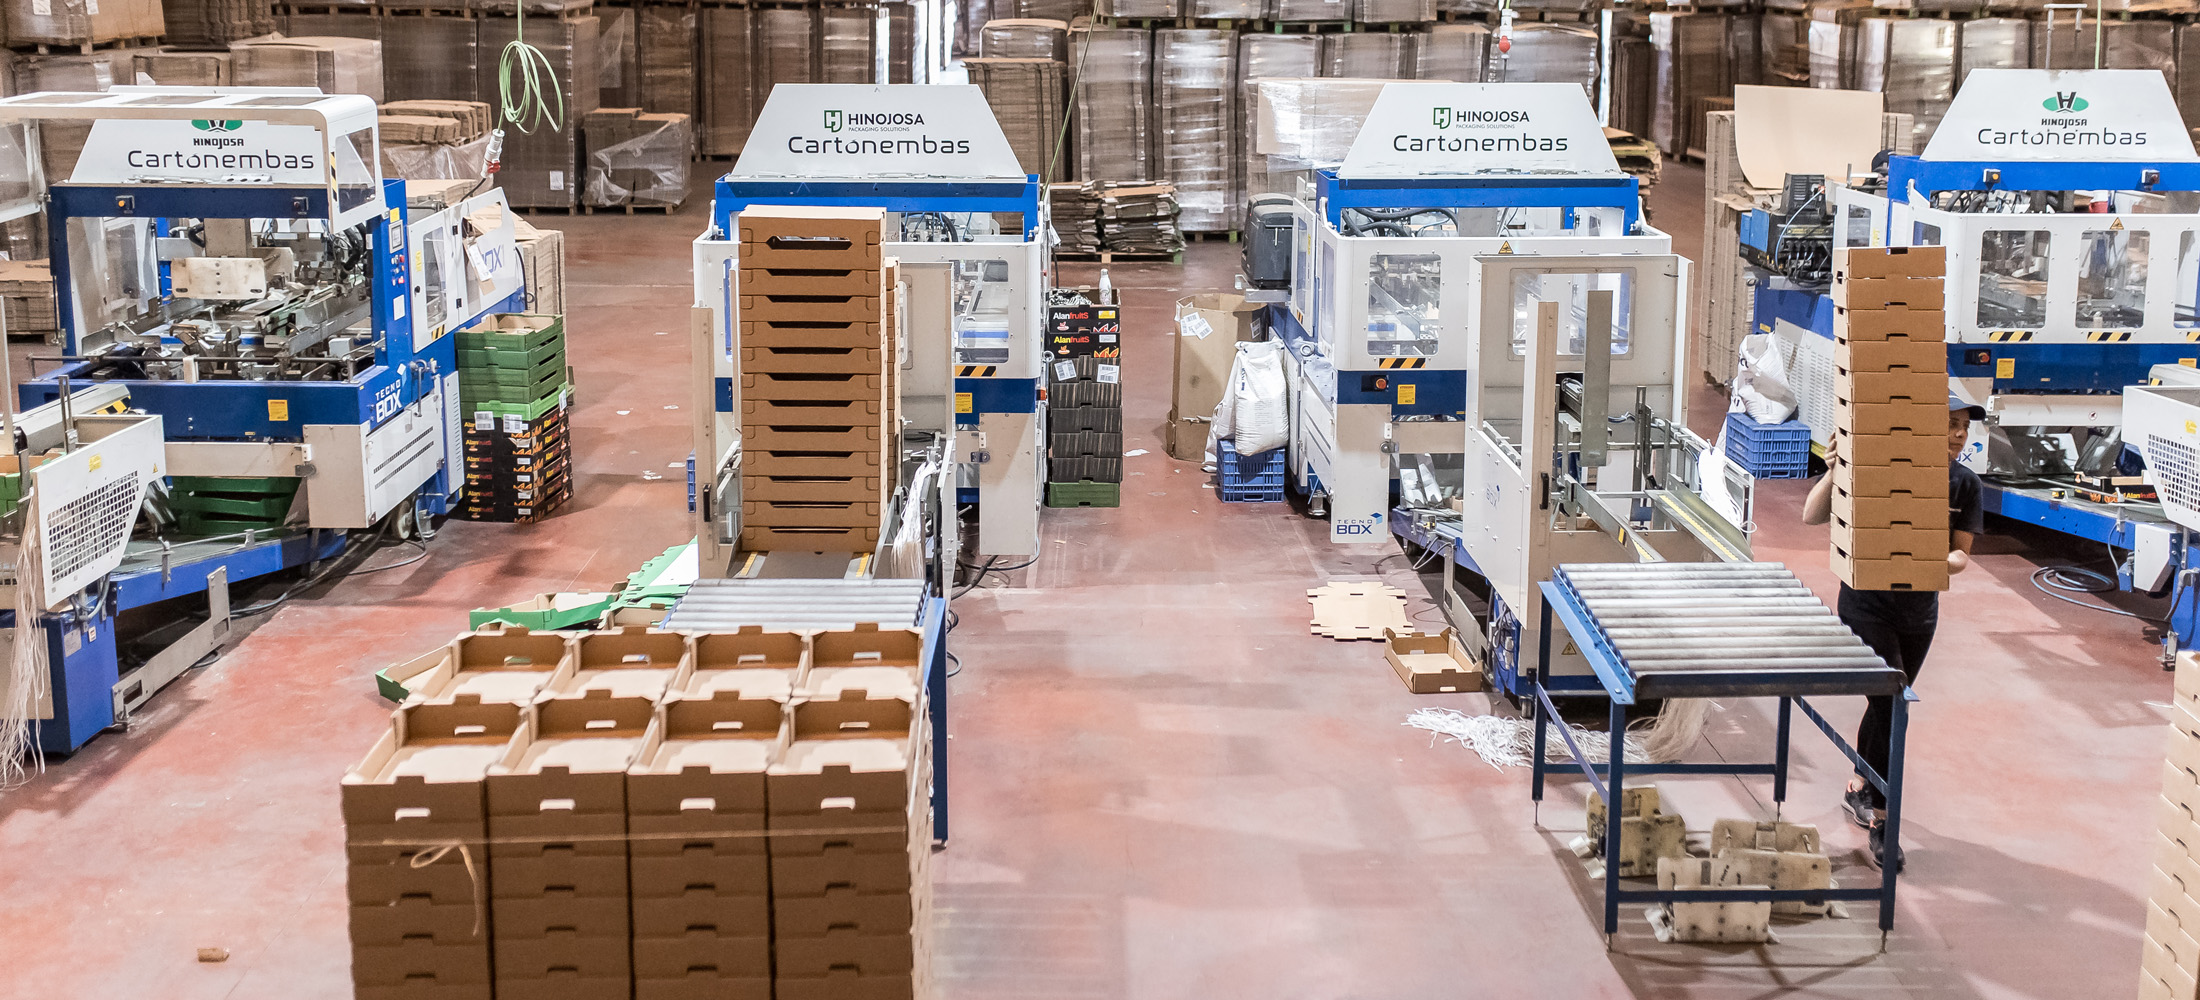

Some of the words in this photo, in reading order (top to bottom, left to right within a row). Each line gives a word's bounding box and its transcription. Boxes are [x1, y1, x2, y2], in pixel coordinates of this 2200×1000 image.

[848, 113, 925, 126] HINOJOSA
[1456, 110, 1530, 123] HINOJOSA
[2040, 118, 2088, 129] HINOJOSA
[193, 138, 244, 149] HINOJOSA
[375, 379, 401, 401] TECNO
[376, 389, 403, 423] BOX
[1337, 525, 1373, 535] BOX
